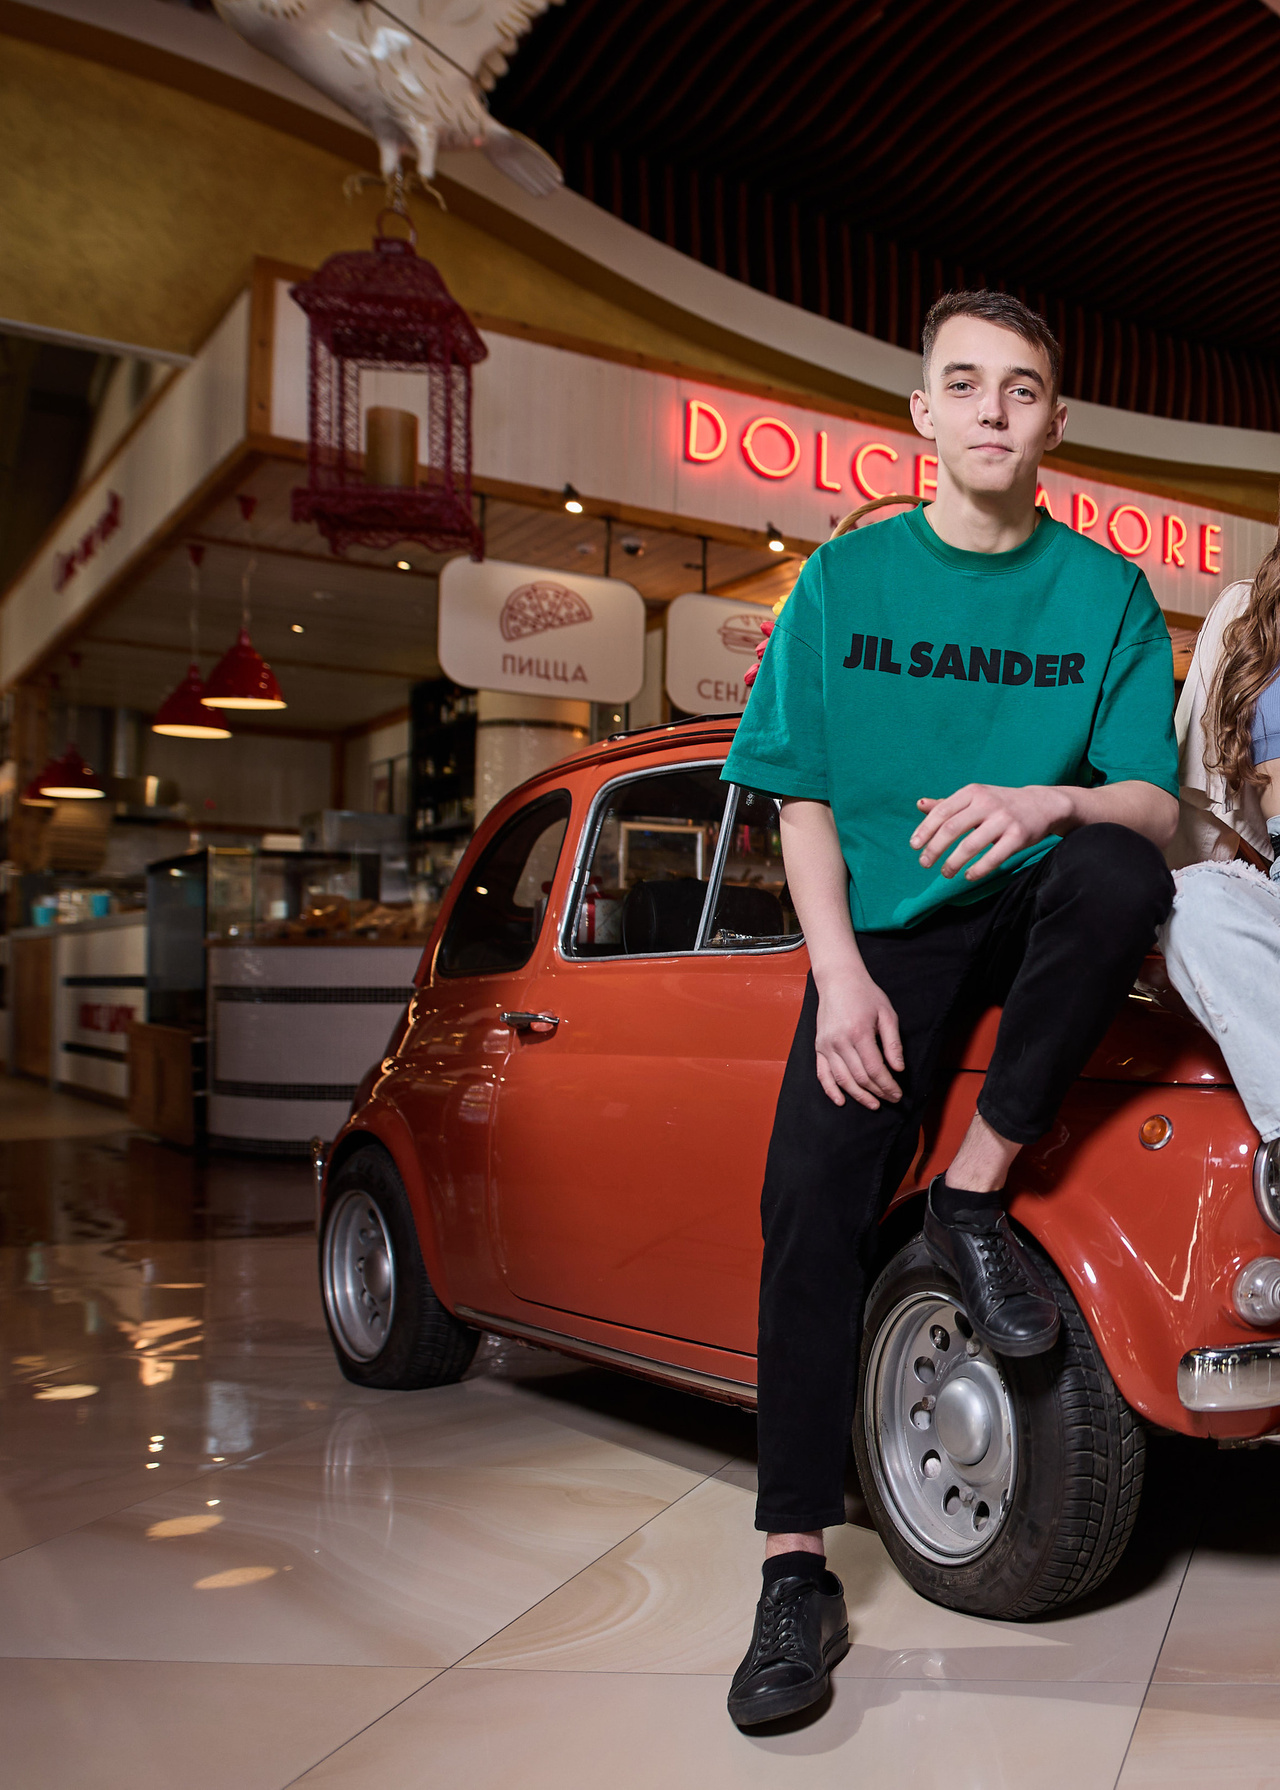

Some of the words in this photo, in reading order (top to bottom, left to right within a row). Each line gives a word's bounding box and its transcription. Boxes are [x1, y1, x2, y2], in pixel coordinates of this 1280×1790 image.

[684, 397, 938, 507] DOLCE
[1034, 482, 1222, 574] APORE
[501, 653, 589, 684] ПИЦЦА
[842, 633, 902, 675] JIL
[907, 641, 1086, 688] SANDER
